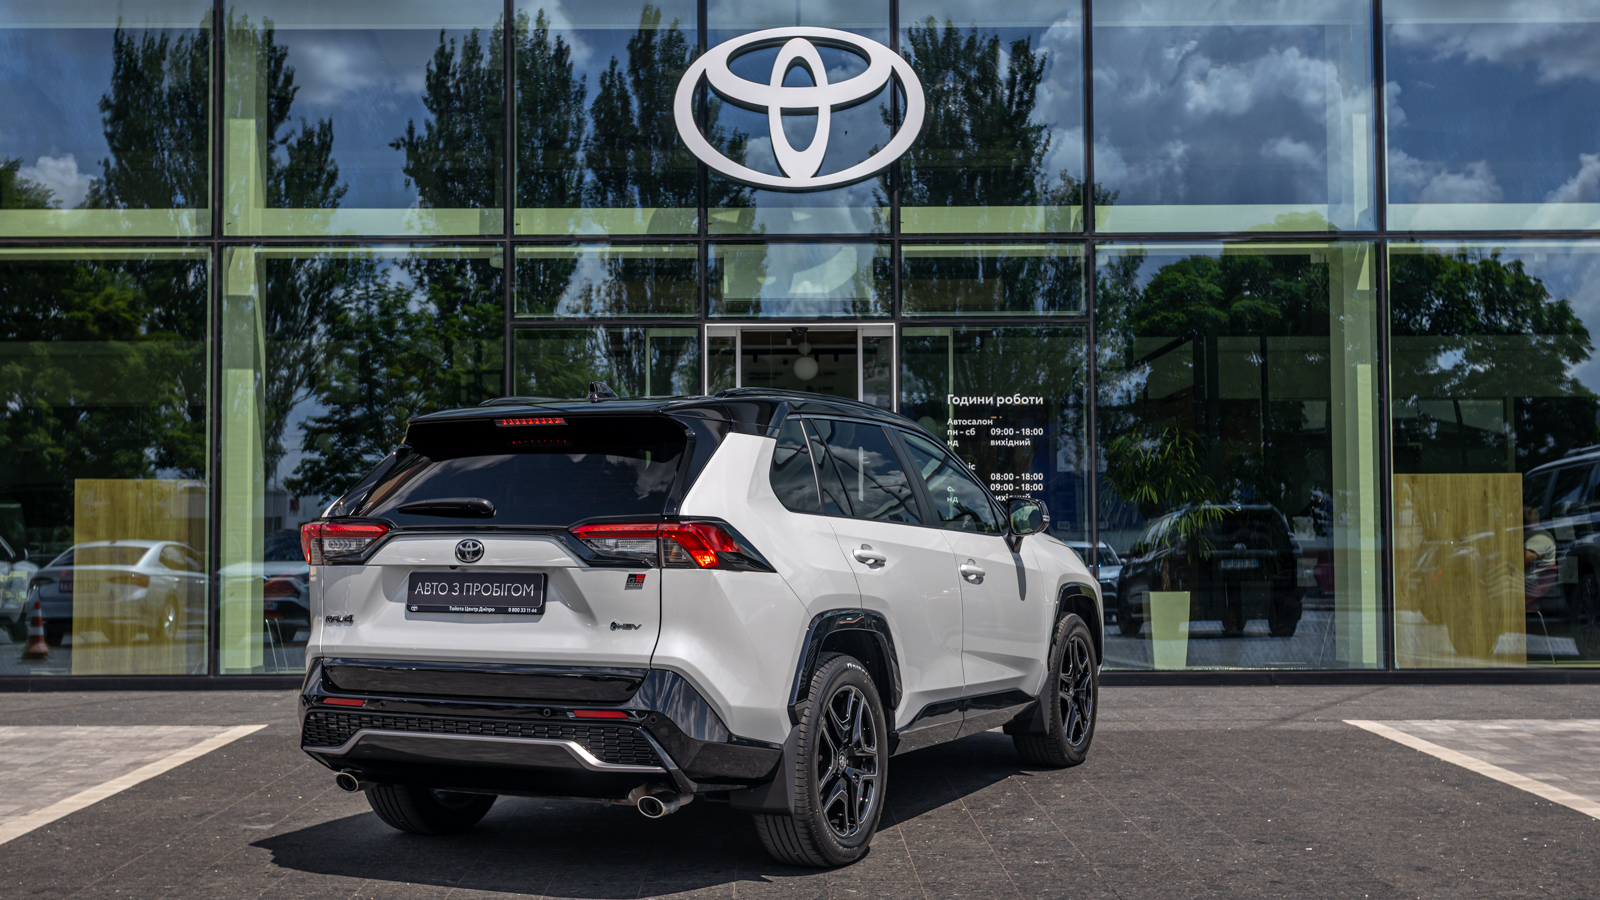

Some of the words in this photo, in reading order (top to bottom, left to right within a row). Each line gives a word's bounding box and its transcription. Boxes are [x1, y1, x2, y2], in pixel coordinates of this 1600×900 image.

[947, 394, 994, 406] Години
[997, 393, 1044, 407] роботи
[990, 428, 1014, 436] 09:00
[1021, 428, 1044, 436] 18:00
[990, 438, 1031, 447] вихідний
[990, 473, 1014, 481] 08:00
[1021, 473, 1044, 481] 18:00
[990, 483, 1014, 491] 09:00
[1021, 483, 1044, 491] 18:00
[414, 582, 449, 595] АВТО
[463, 582, 535, 597] ПРОБІГОМ
[325, 615, 354, 624] RAV4
